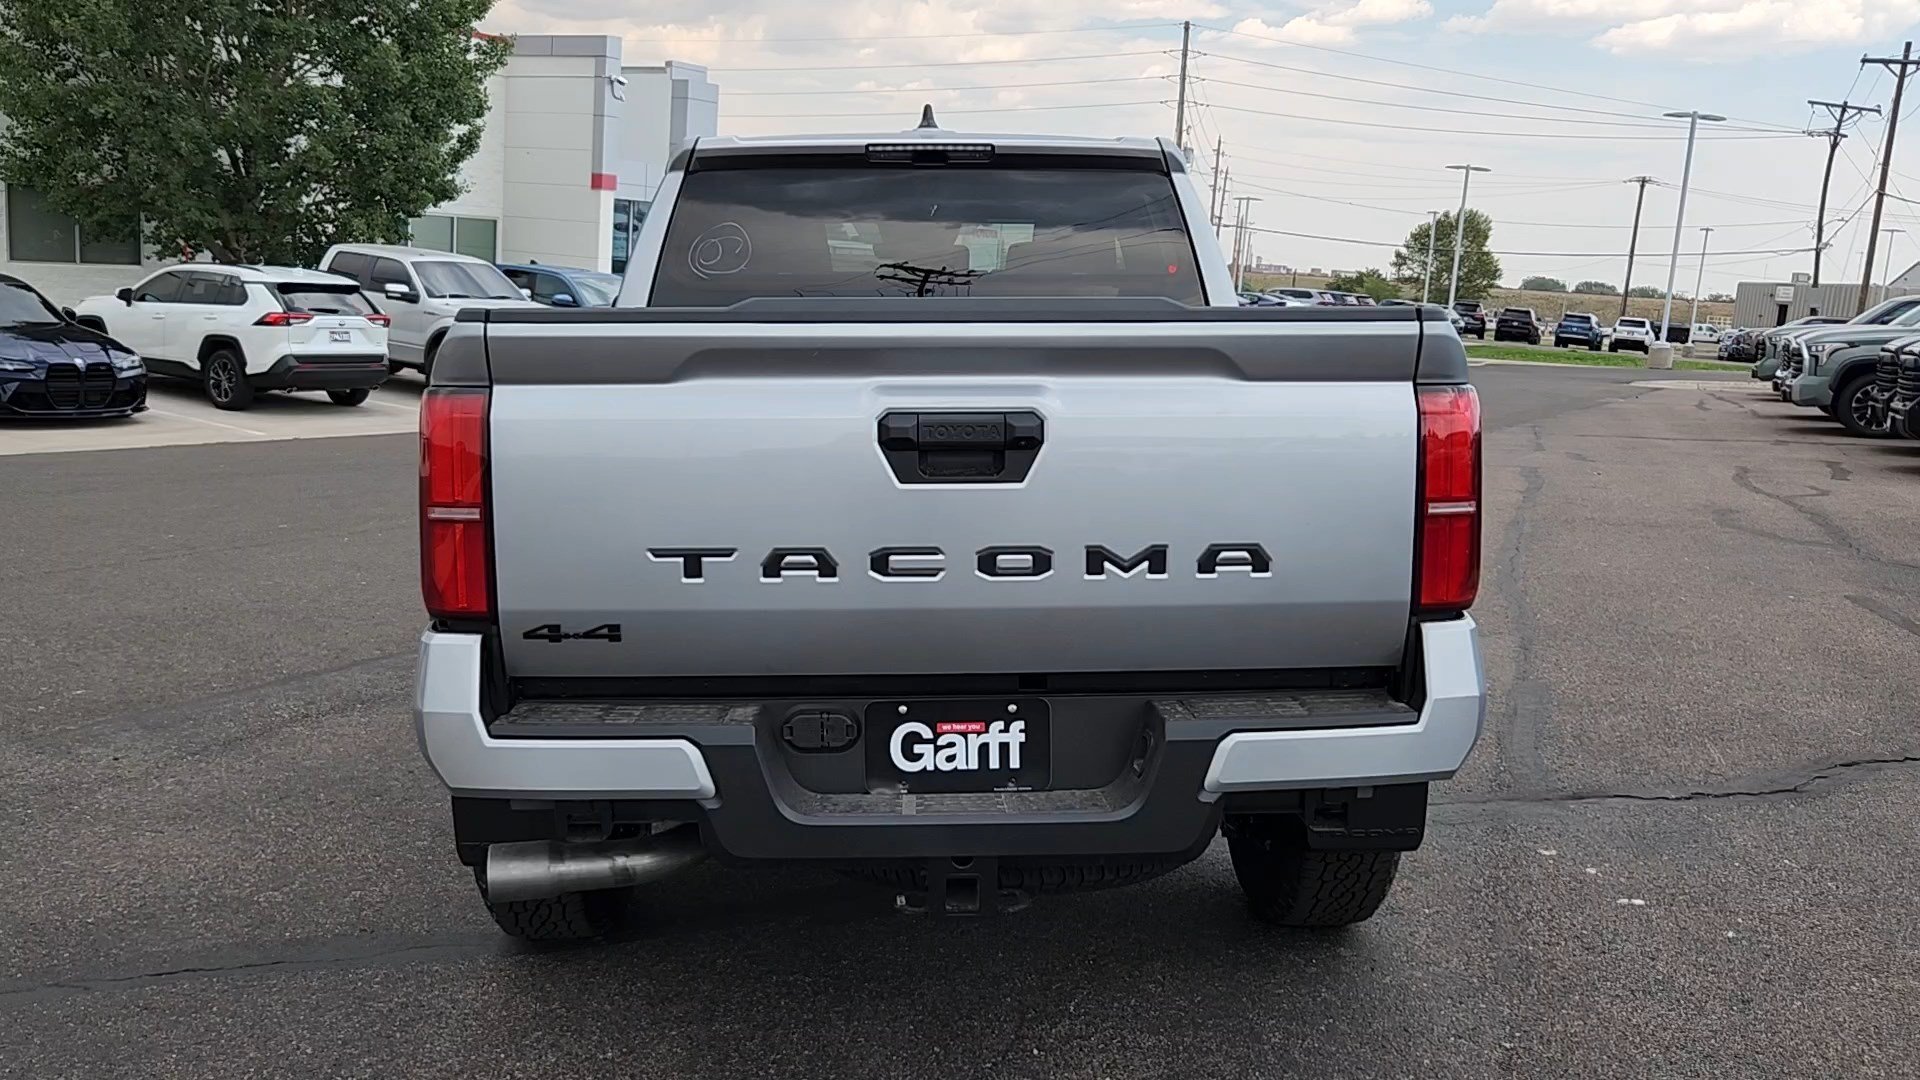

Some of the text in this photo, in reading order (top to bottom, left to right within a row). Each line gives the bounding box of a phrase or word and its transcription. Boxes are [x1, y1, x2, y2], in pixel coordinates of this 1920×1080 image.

[922, 424, 1001, 440] TOYOTA
[646, 542, 1273, 583] TACOMA
[953, 723, 967, 731] hear
[968, 723, 981, 732] you
[890, 720, 1026, 772] Garff
